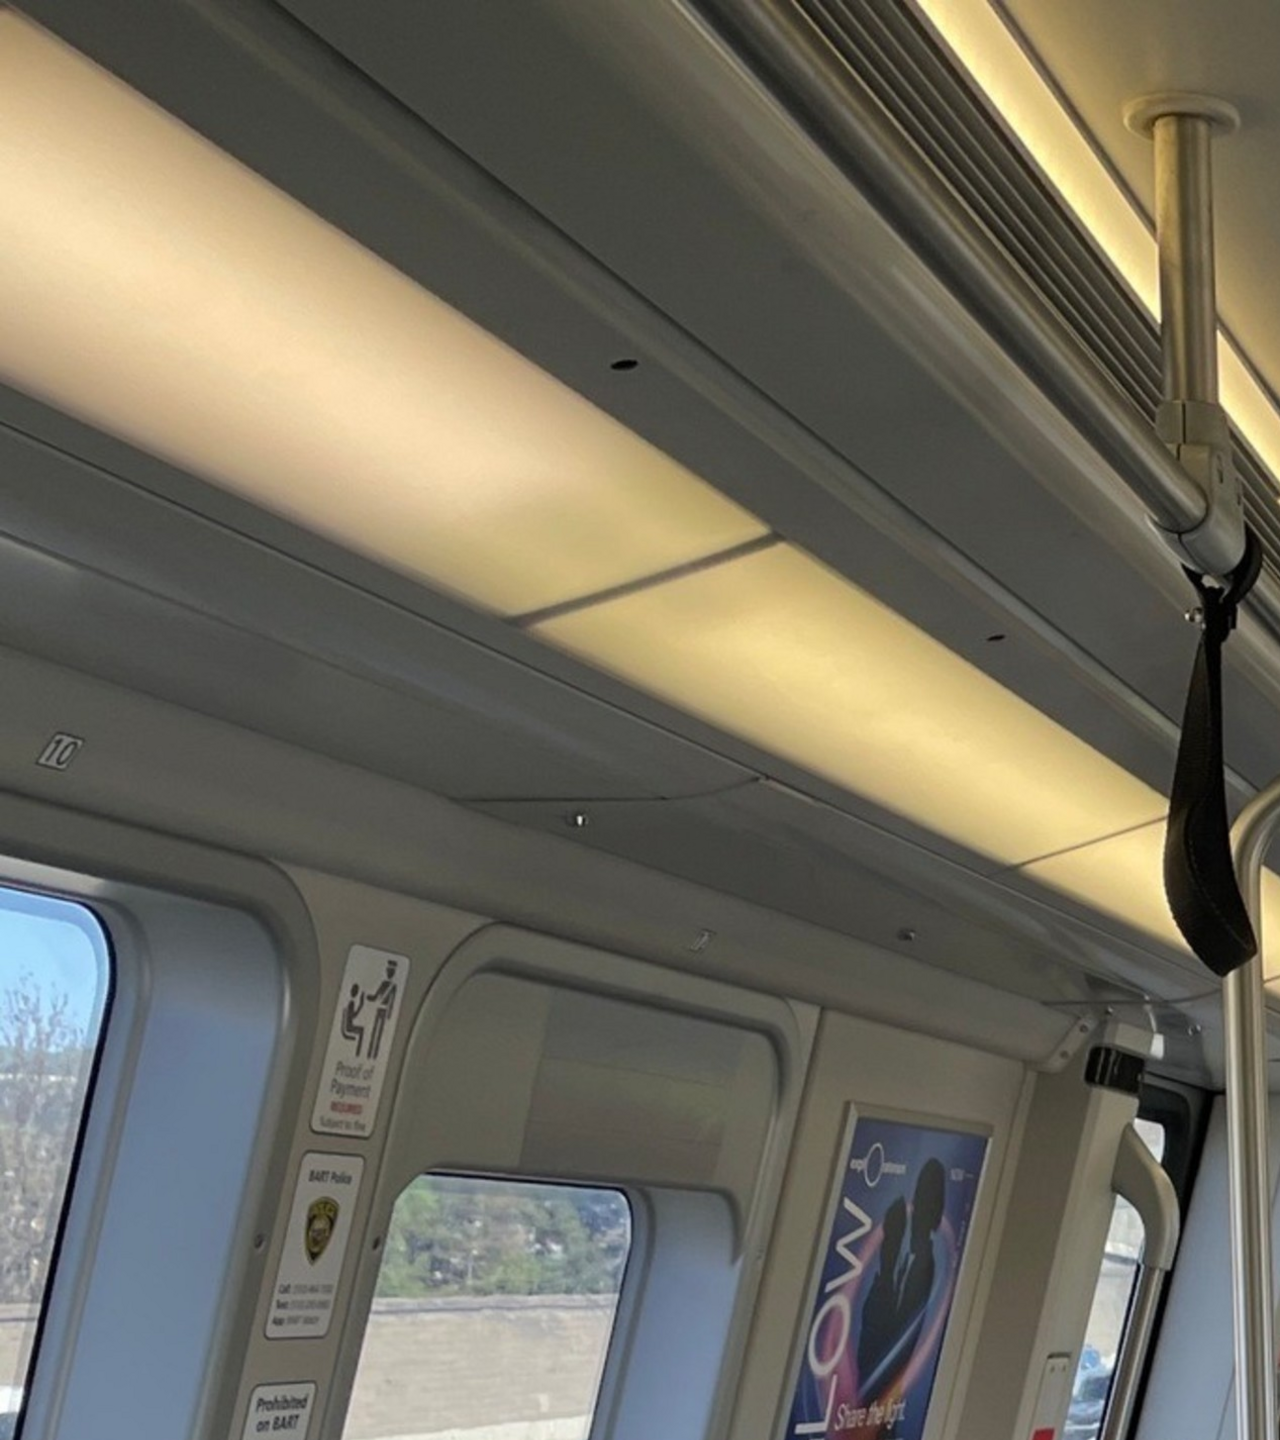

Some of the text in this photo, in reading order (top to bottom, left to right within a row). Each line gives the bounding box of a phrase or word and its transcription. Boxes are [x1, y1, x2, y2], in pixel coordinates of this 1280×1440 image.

[45, 739, 78, 766] 10
[335, 1061, 376, 1081] Proof of
[330, 1078, 371, 1100] Payment
[308, 1170, 353, 1186] BART Police
[256, 1394, 310, 1413] Prohibited
[256, 1414, 300, 1433] on BART
[834, 1403, 867, 1431] Share
[866, 1400, 884, 1426] the
